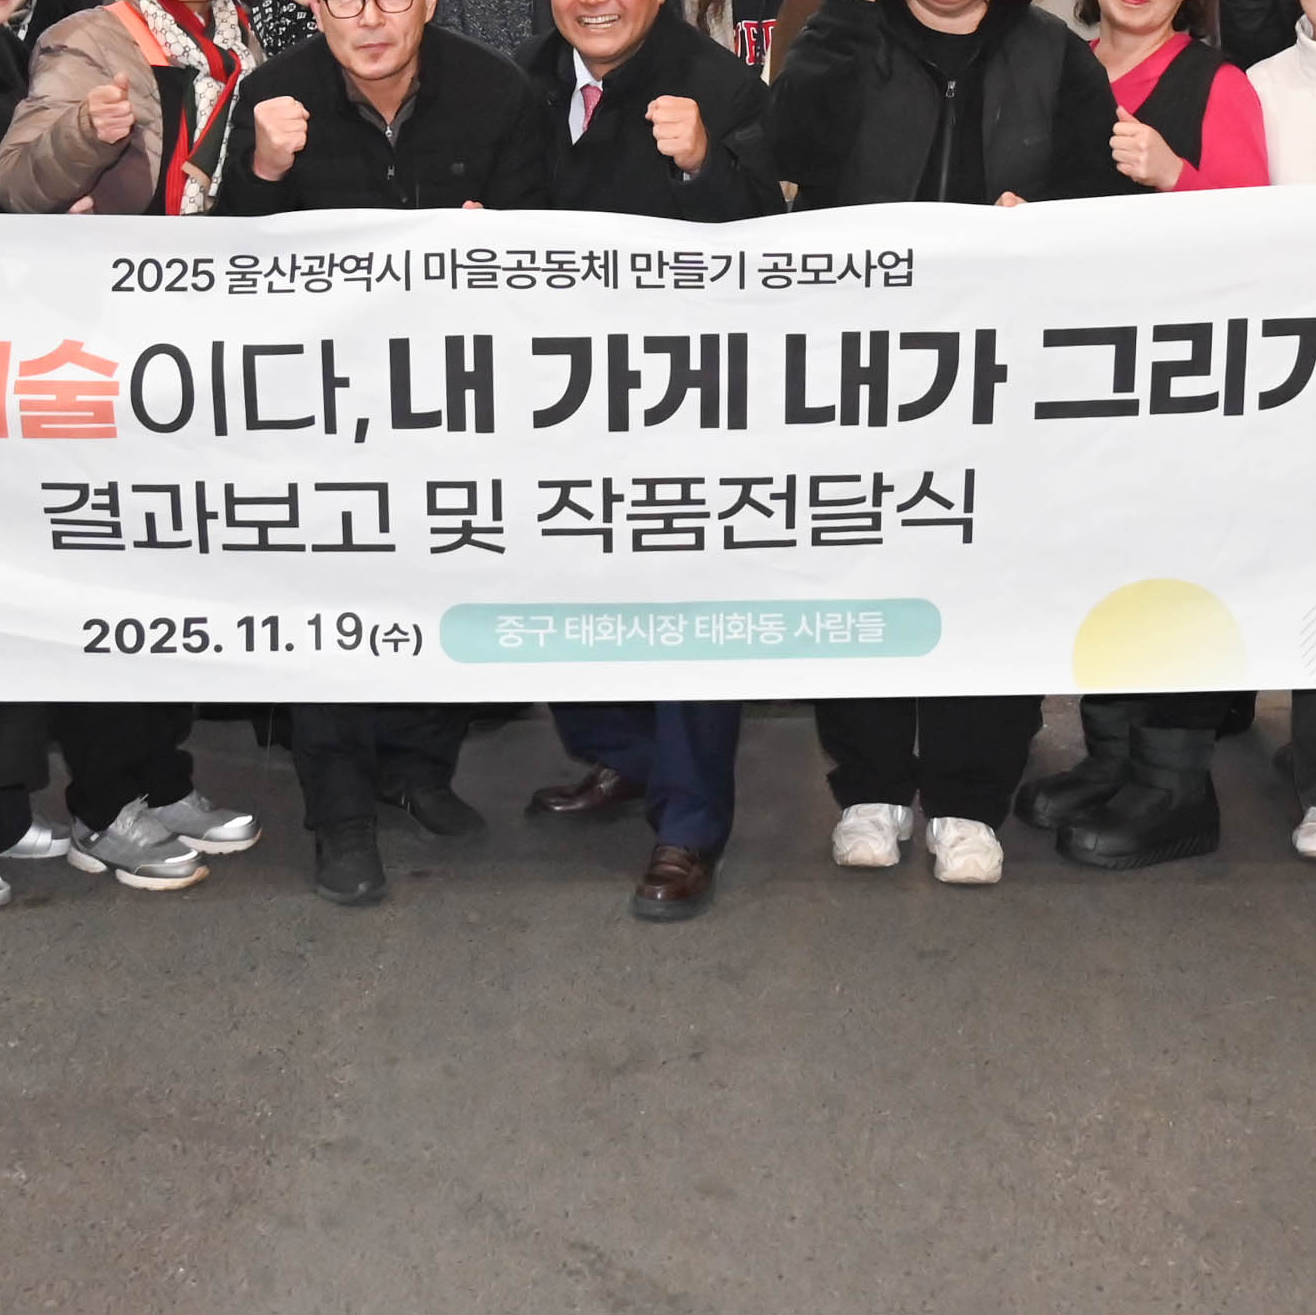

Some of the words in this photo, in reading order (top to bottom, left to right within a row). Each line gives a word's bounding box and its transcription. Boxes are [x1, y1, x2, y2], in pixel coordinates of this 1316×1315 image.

[111, 258, 215, 293] 2025
[225, 249, 411, 295] 울산광역시
[424, 248, 619, 290] 마을공동체
[630, 249, 745, 290] 만들기
[757, 247, 914, 289] 공모사업
[531, 332, 748, 433] 가게
[784, 328, 1008, 428] 내가
[41, 480, 396, 554] 결과보고
[426, 478, 506, 555] 및
[537, 468, 975, 554] 작품전달식
[496, 616, 558, 648] 중구
[564, 614, 687, 647] 태화시장
[695, 612, 787, 645] 태화동
[794, 611, 886, 644] 사람들
